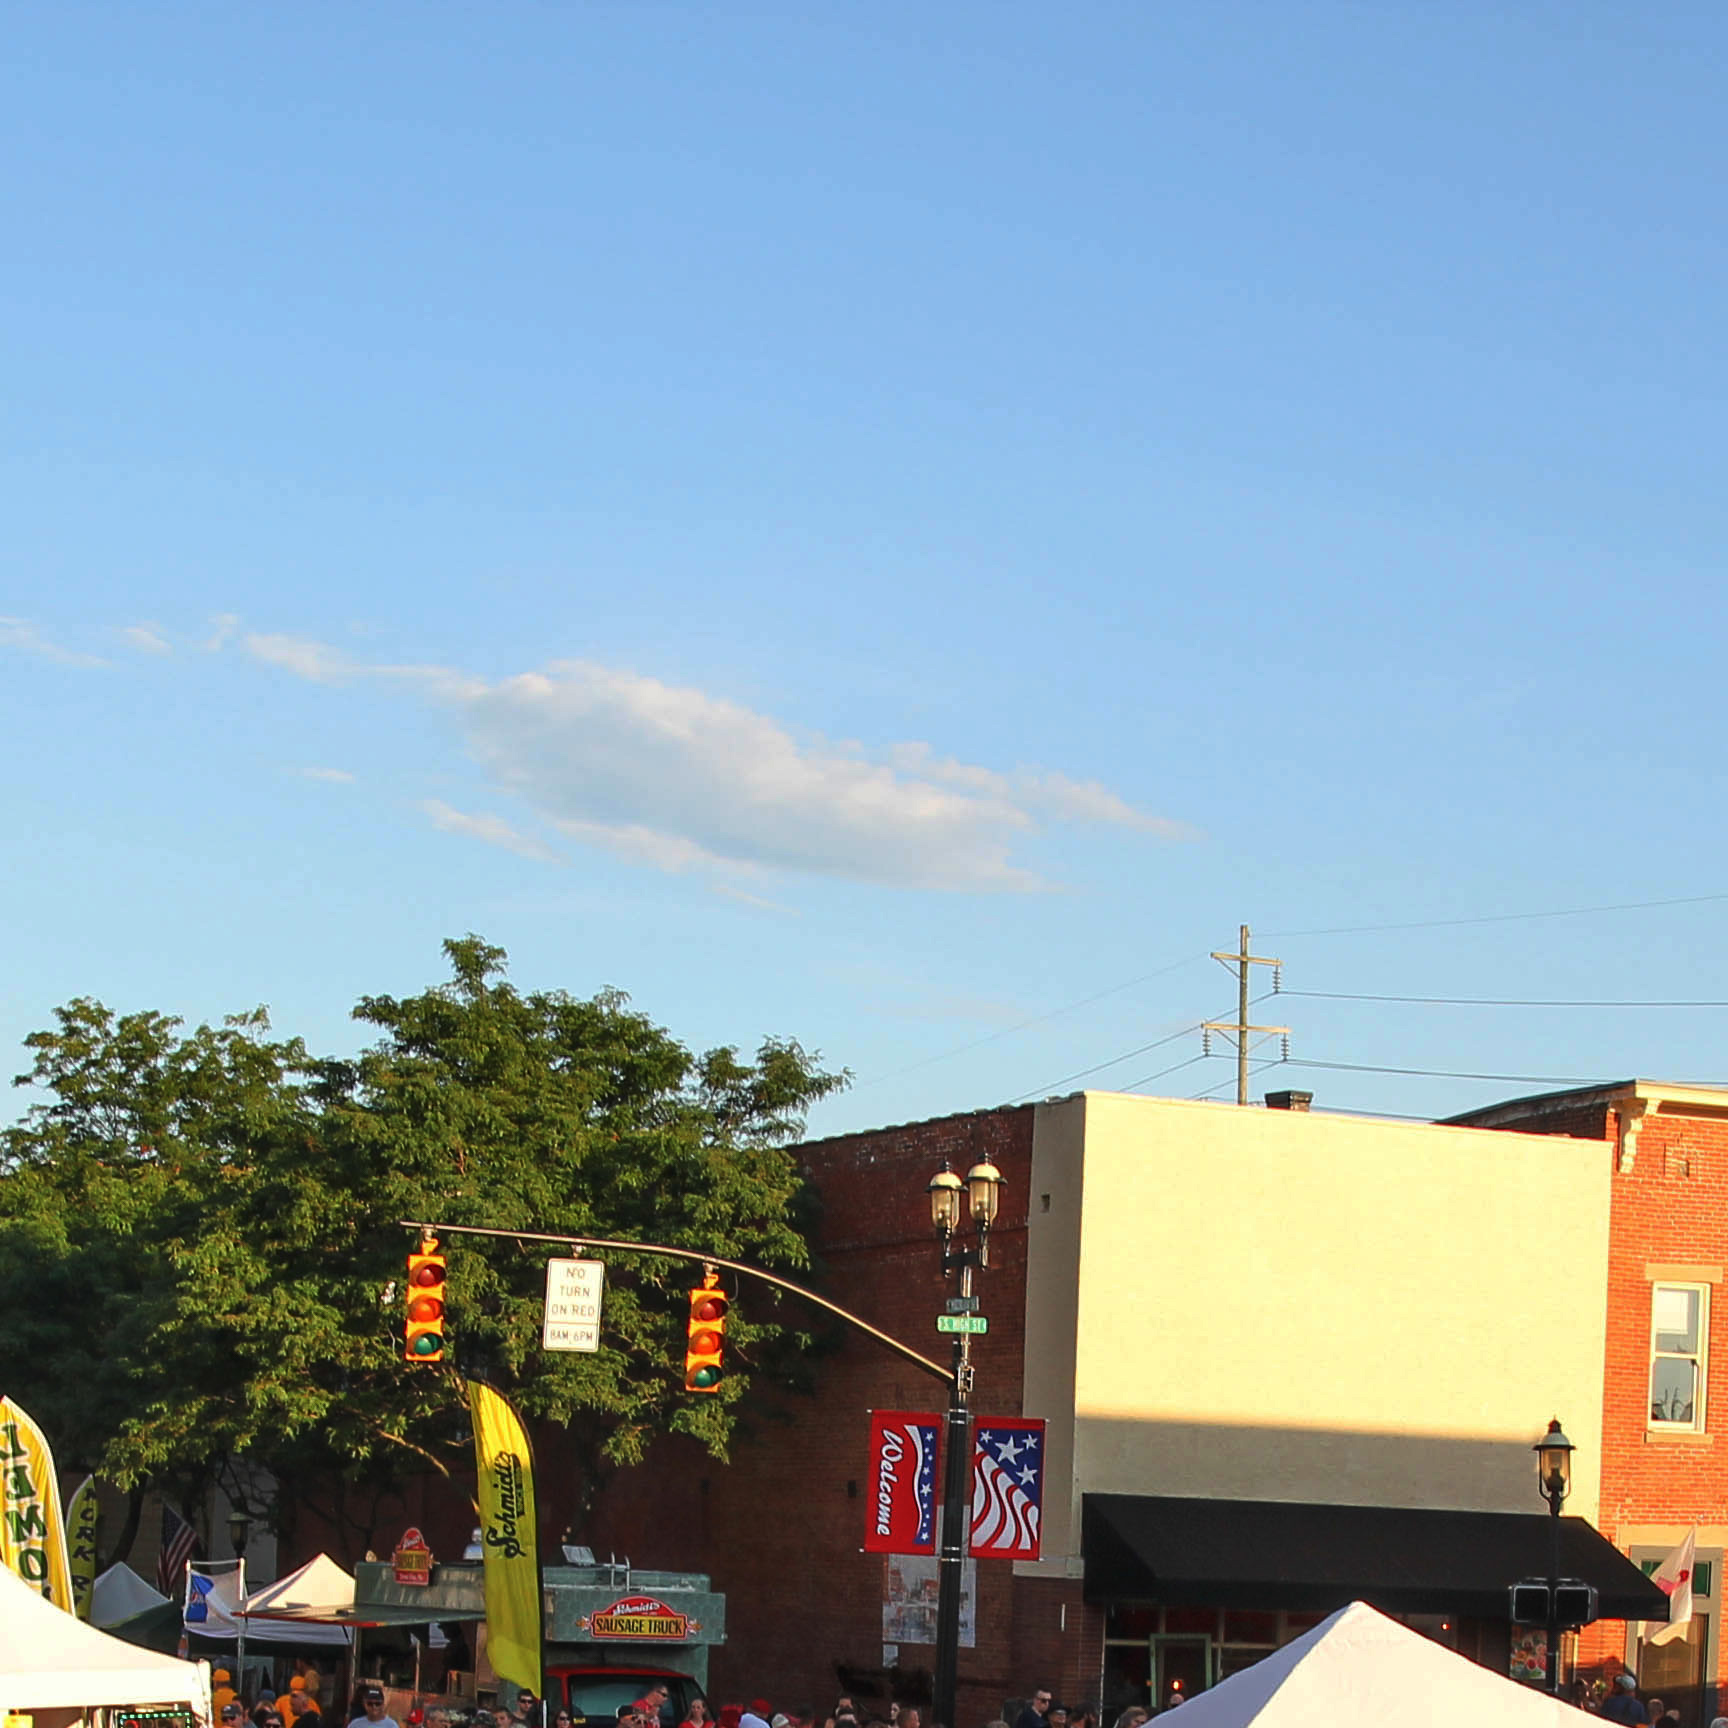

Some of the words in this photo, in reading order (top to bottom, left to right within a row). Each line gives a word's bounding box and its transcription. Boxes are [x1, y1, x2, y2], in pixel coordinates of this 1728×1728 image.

[566, 1267, 586, 1279] NO
[560, 1285, 590, 1297] TURN
[552, 1303, 567, 1315] ON
[572, 1304, 595, 1317] RED
[877, 1429, 904, 1536] Welcome
[596, 1618, 646, 1634] SAUSAGE
[649, 1619, 682, 1635] TRUCK
